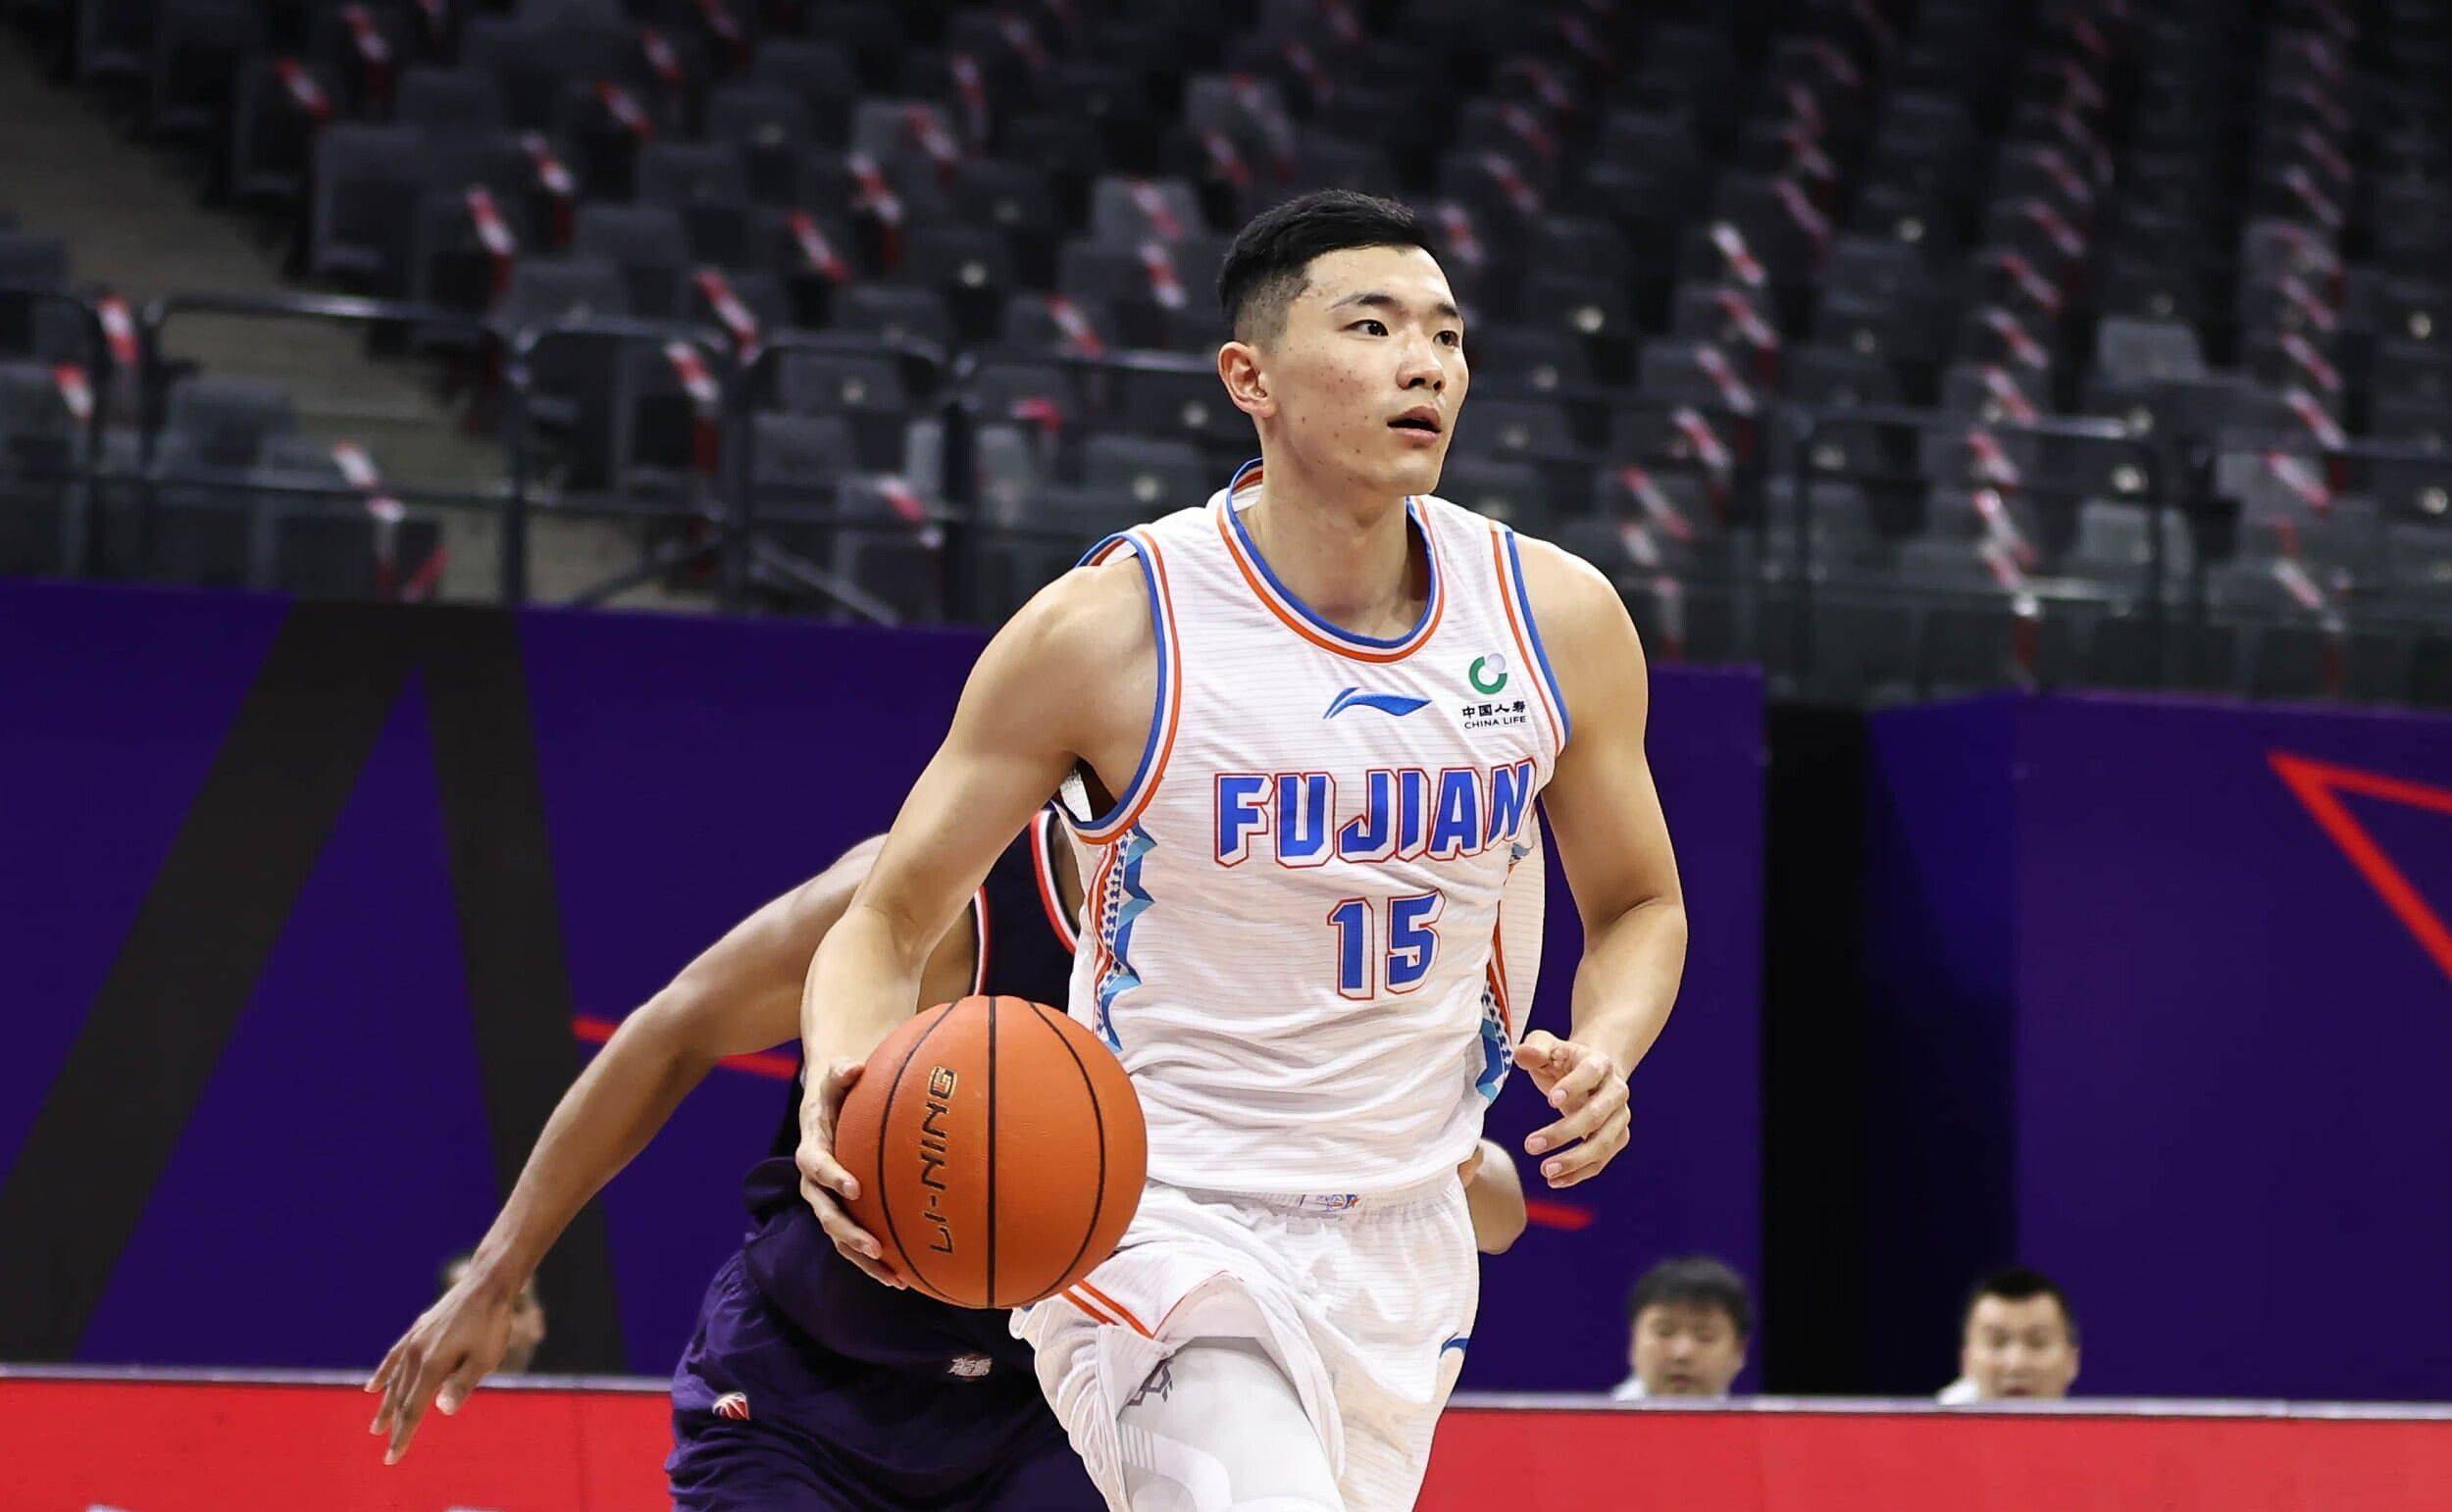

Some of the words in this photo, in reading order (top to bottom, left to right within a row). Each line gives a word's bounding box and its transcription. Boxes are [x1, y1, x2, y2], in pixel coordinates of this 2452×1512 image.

[1462, 700, 1525, 719] 中国人寿
[1464, 719, 1500, 730] CHINA
[1503, 715, 1527, 726] LIFE
[1214, 757, 1537, 869] FUJIAN
[1327, 889, 1446, 1000] 15
[920, 1065, 957, 1254] LI-NING
